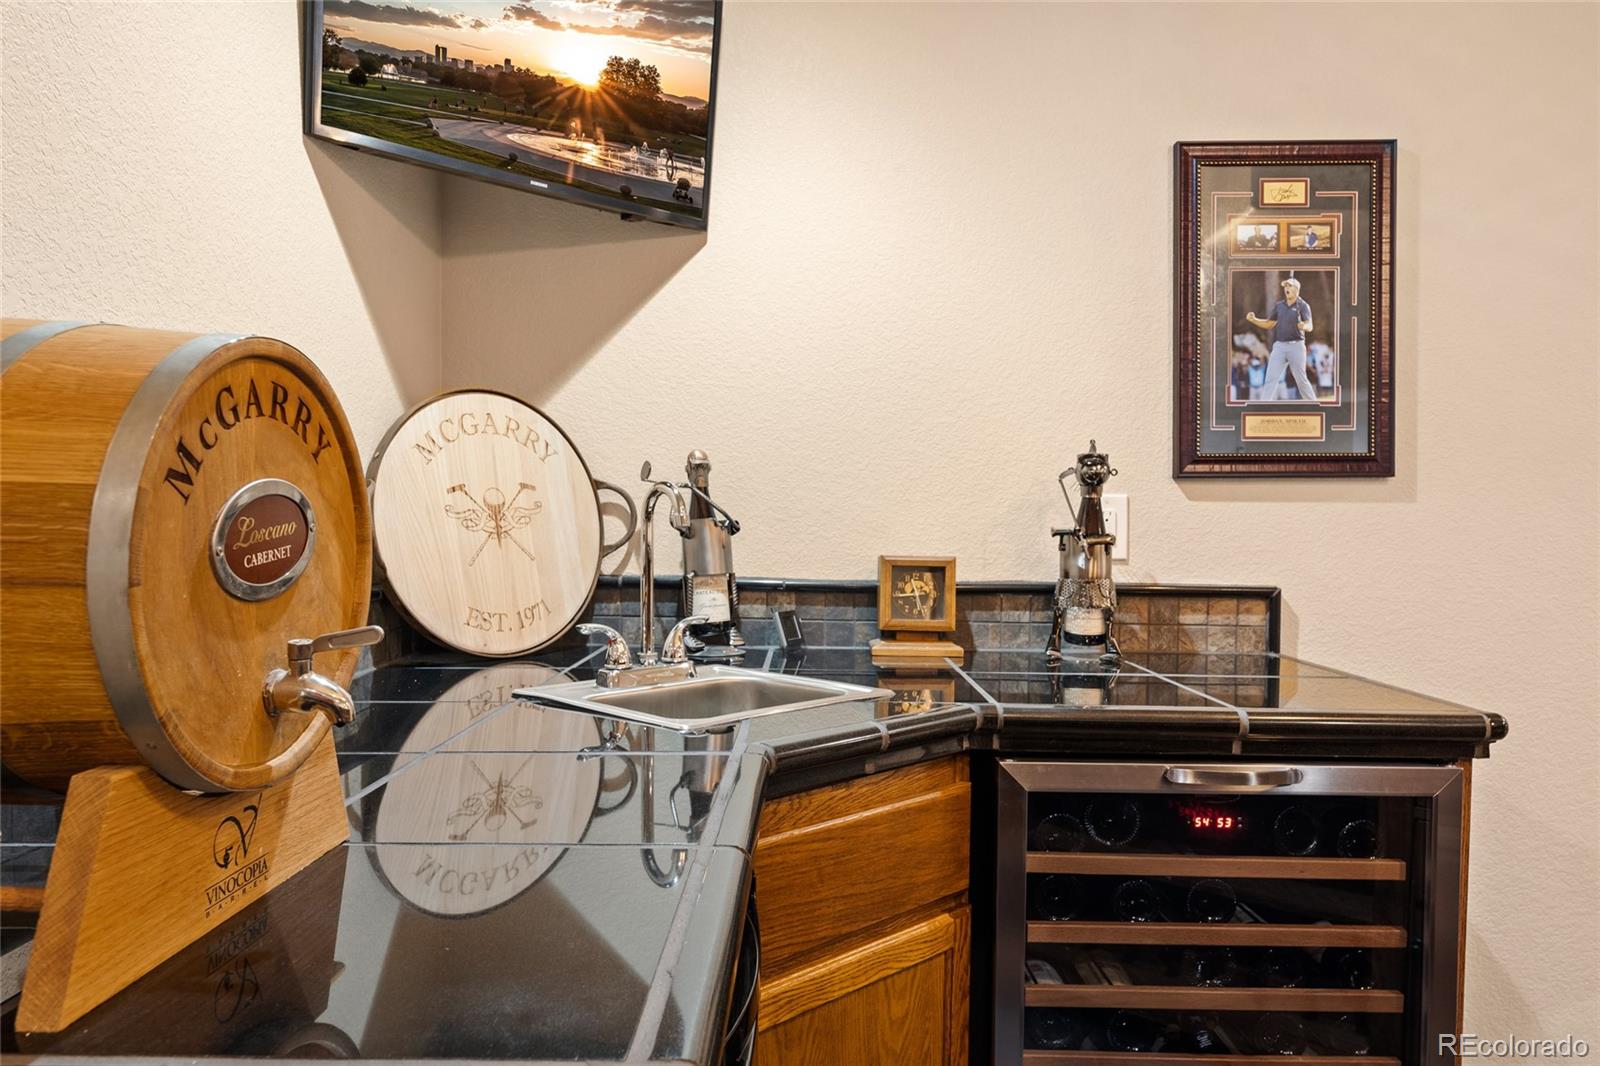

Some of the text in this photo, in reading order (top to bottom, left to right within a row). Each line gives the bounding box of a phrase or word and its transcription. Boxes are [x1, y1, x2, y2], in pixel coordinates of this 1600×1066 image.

[412, 412, 559, 465] MCGARRY
[233, 516, 297, 550] Loscano
[243, 545, 292, 568] CABERNET
[463, 599, 552, 632] EST. 1971
[1194, 816, 1233, 828] 54 53
[206, 857, 268, 905] VINOCOPIA
